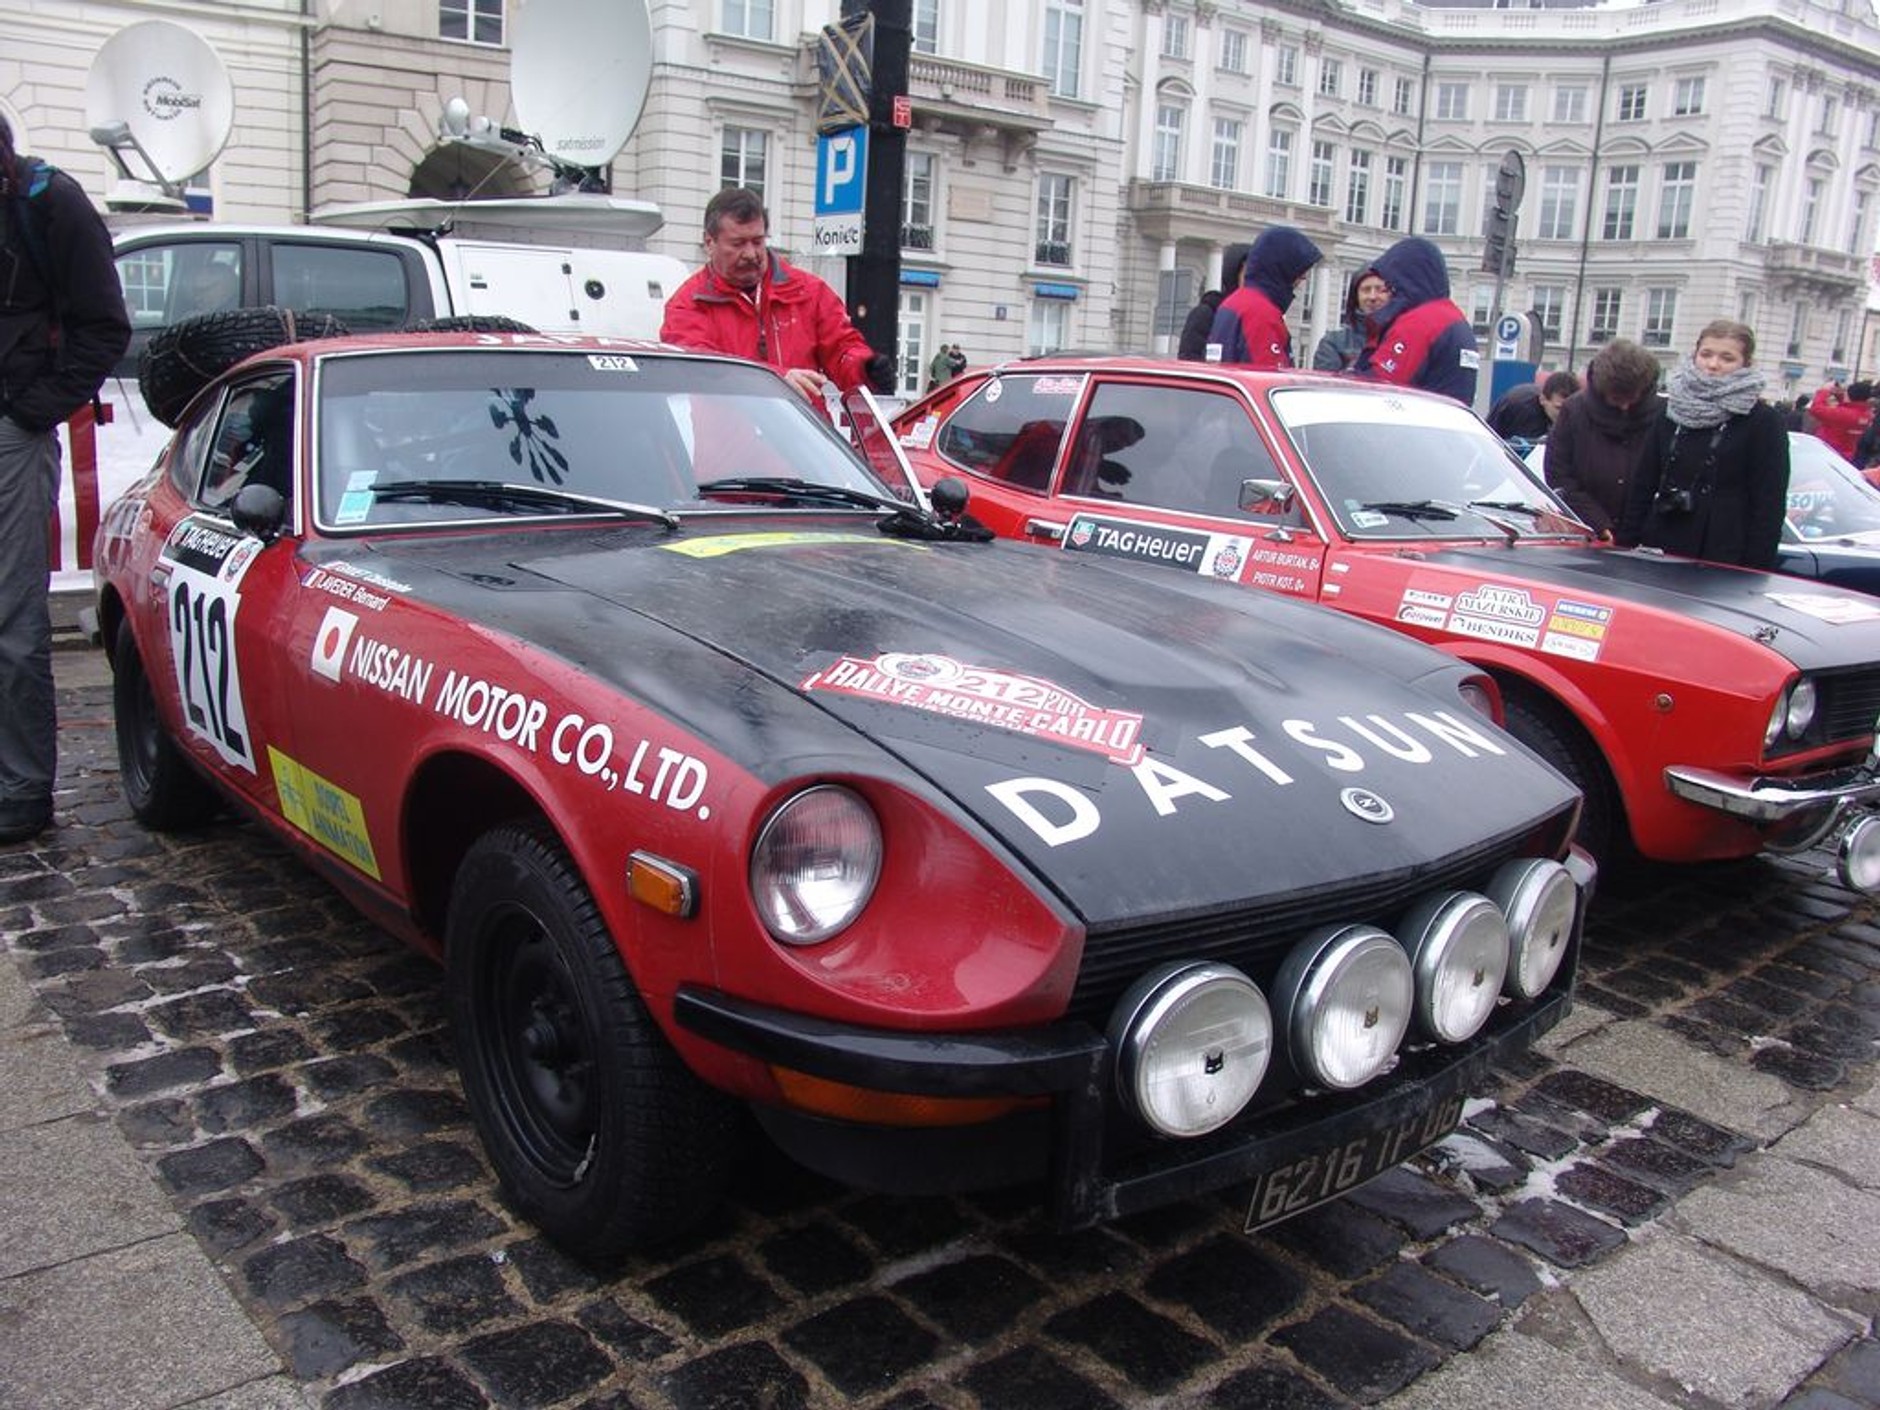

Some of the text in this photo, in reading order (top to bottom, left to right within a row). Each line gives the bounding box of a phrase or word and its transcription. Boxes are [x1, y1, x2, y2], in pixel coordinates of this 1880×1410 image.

[156, 95, 202, 108] MobiSat
[824, 137, 856, 206] P
[814, 224, 859, 246] Koniec
[598, 356, 629, 369] 212
[1466, 620, 1536, 642] BENDIKS
[174, 581, 247, 758] 212
[824, 660, 922, 700] RALLYE
[956, 675, 1087, 718] 212 2011
[348, 634, 711, 820] NISSAN MOTOR CO., LTD.
[984, 710, 1507, 848] DATSUN
[1260, 1137, 1367, 1221] 6216
